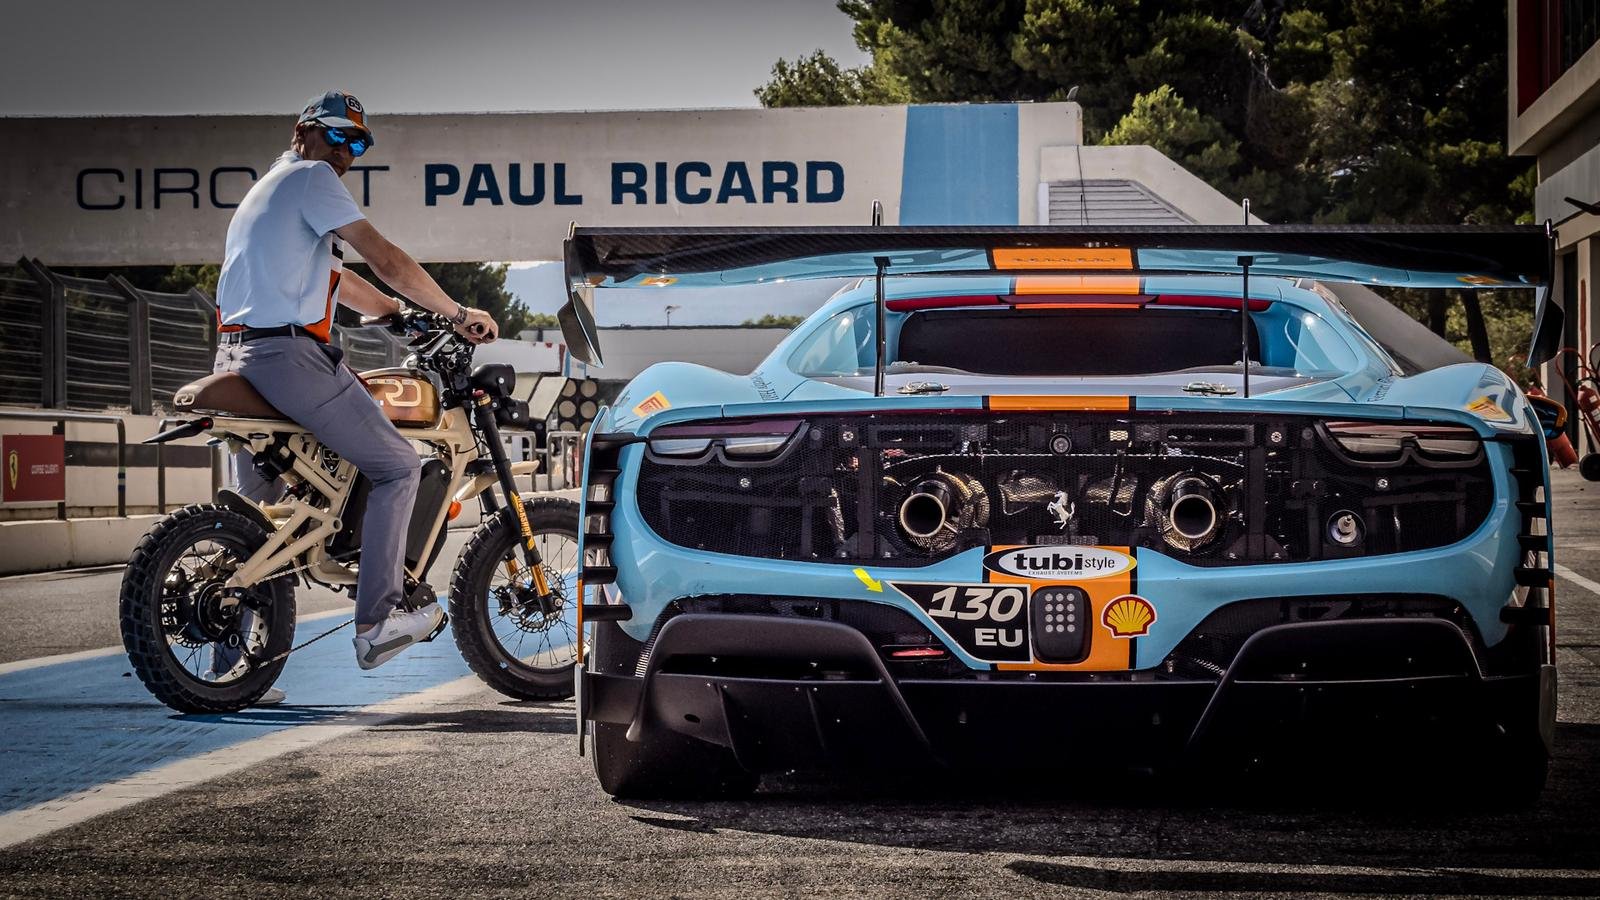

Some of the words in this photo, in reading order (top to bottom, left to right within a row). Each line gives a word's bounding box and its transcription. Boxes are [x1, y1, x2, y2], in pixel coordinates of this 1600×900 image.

[76, 165, 389, 210] CIRCT
[424, 163, 583, 206] PAUL
[611, 161, 845, 204] RICARD
[1013, 553, 1083, 571] tubi
[1084, 556, 1116, 571] style
[928, 586, 1024, 623] 130
[974, 627, 1024, 648] EU
